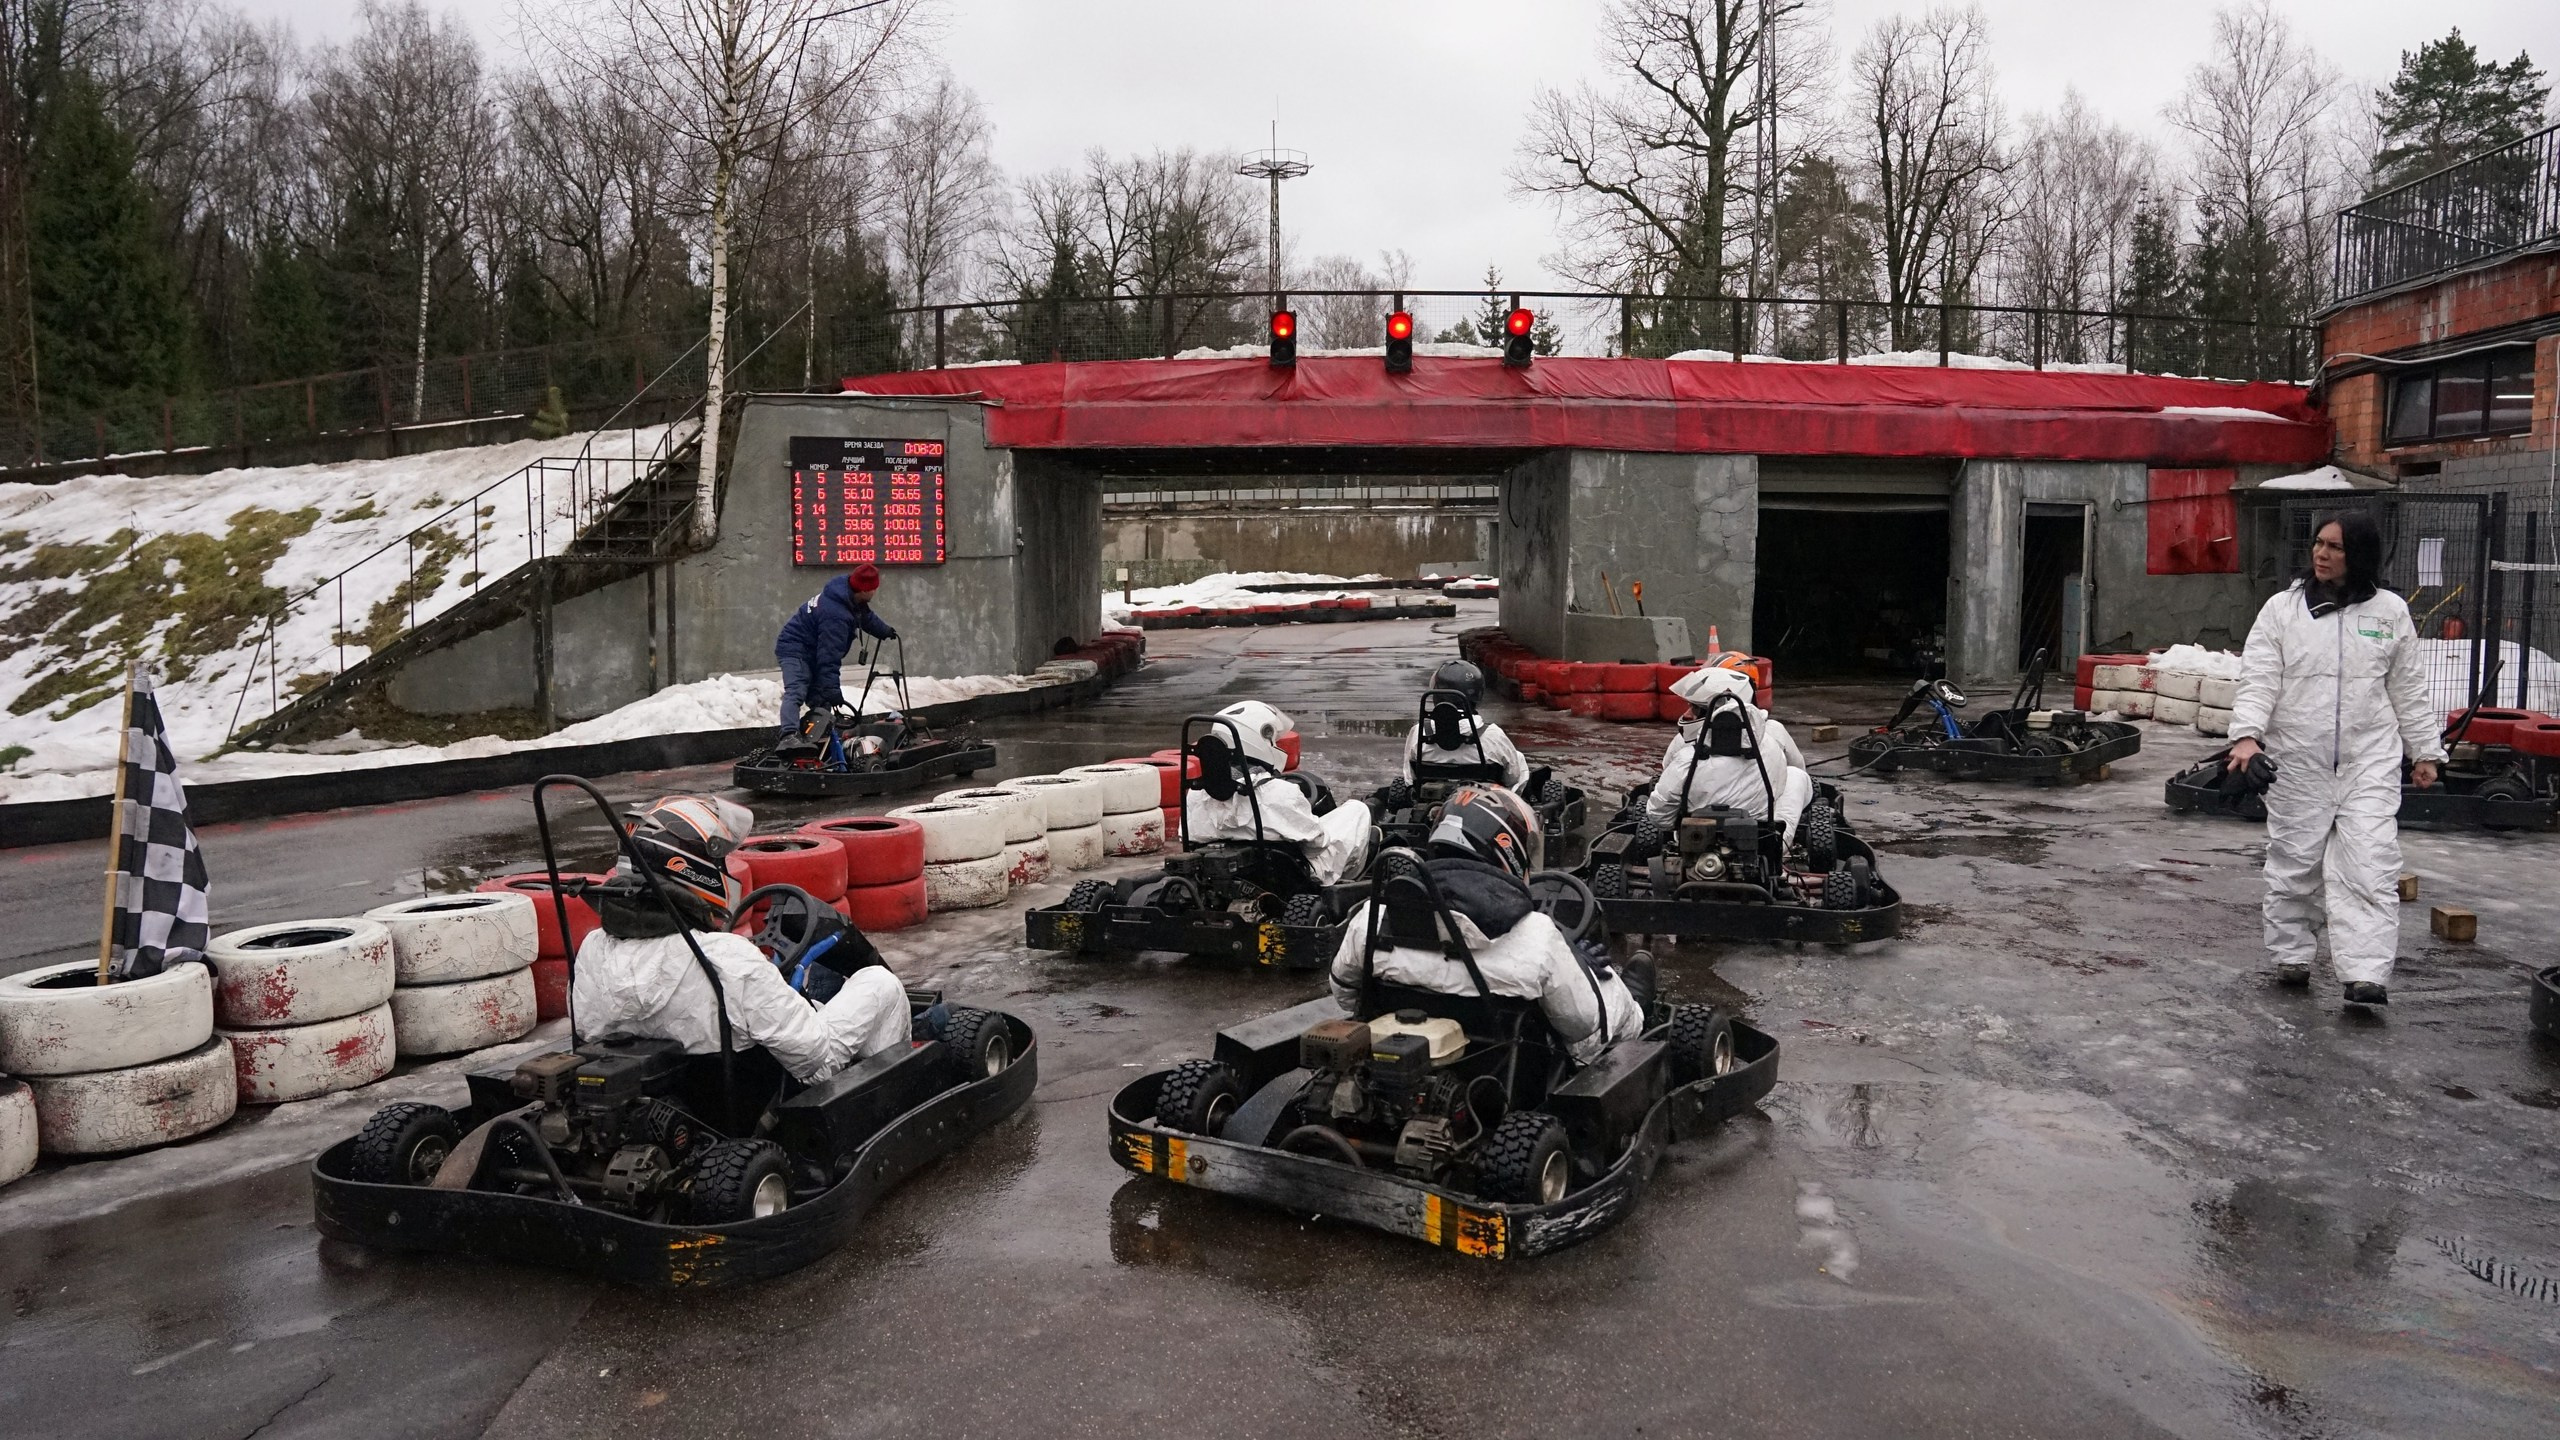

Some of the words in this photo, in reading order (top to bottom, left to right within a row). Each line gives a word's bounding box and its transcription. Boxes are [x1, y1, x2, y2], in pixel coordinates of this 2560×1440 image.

[863, 441, 885, 449] ЗАЕЗДА
[841, 456, 865, 464] ЛУЧШИЙ
[885, 457, 918, 465] ПОСЛЕДНИЙ
[924, 465, 943, 473] КРУГИ
[794, 472, 802, 484] 1
[817, 472, 825, 484] 5
[843, 473, 873, 485] 53.21
[891, 473, 920, 485] 56.32
[935, 474, 943, 486] 6
[793, 488, 802, 500] 2
[817, 488, 825, 500] 6
[843, 488, 874, 500] 56.10
[891, 488, 920, 500] 56.65
[935, 489, 943, 501] 6
[794, 503, 803, 515] 3
[812, 503, 826, 515] 14
[844, 504, 874, 516] 56.71
[935, 504, 943, 516] 6
[794, 519, 803, 531] 4
[818, 519, 826, 531] 3
[883, 519, 921, 531] 1:00.81
[936, 519, 944, 531] 6
[795, 534, 804, 547] 5
[819, 534, 827, 546] 1
[836, 534, 874, 546] 1:00.34
[884, 534, 922, 546] 1:01.16
[936, 534, 944, 546] 6
[795, 550, 804, 562] 6
[819, 550, 827, 562] 7
[936, 549, 944, 561] 2
[805, 722, 815, 734] 7
